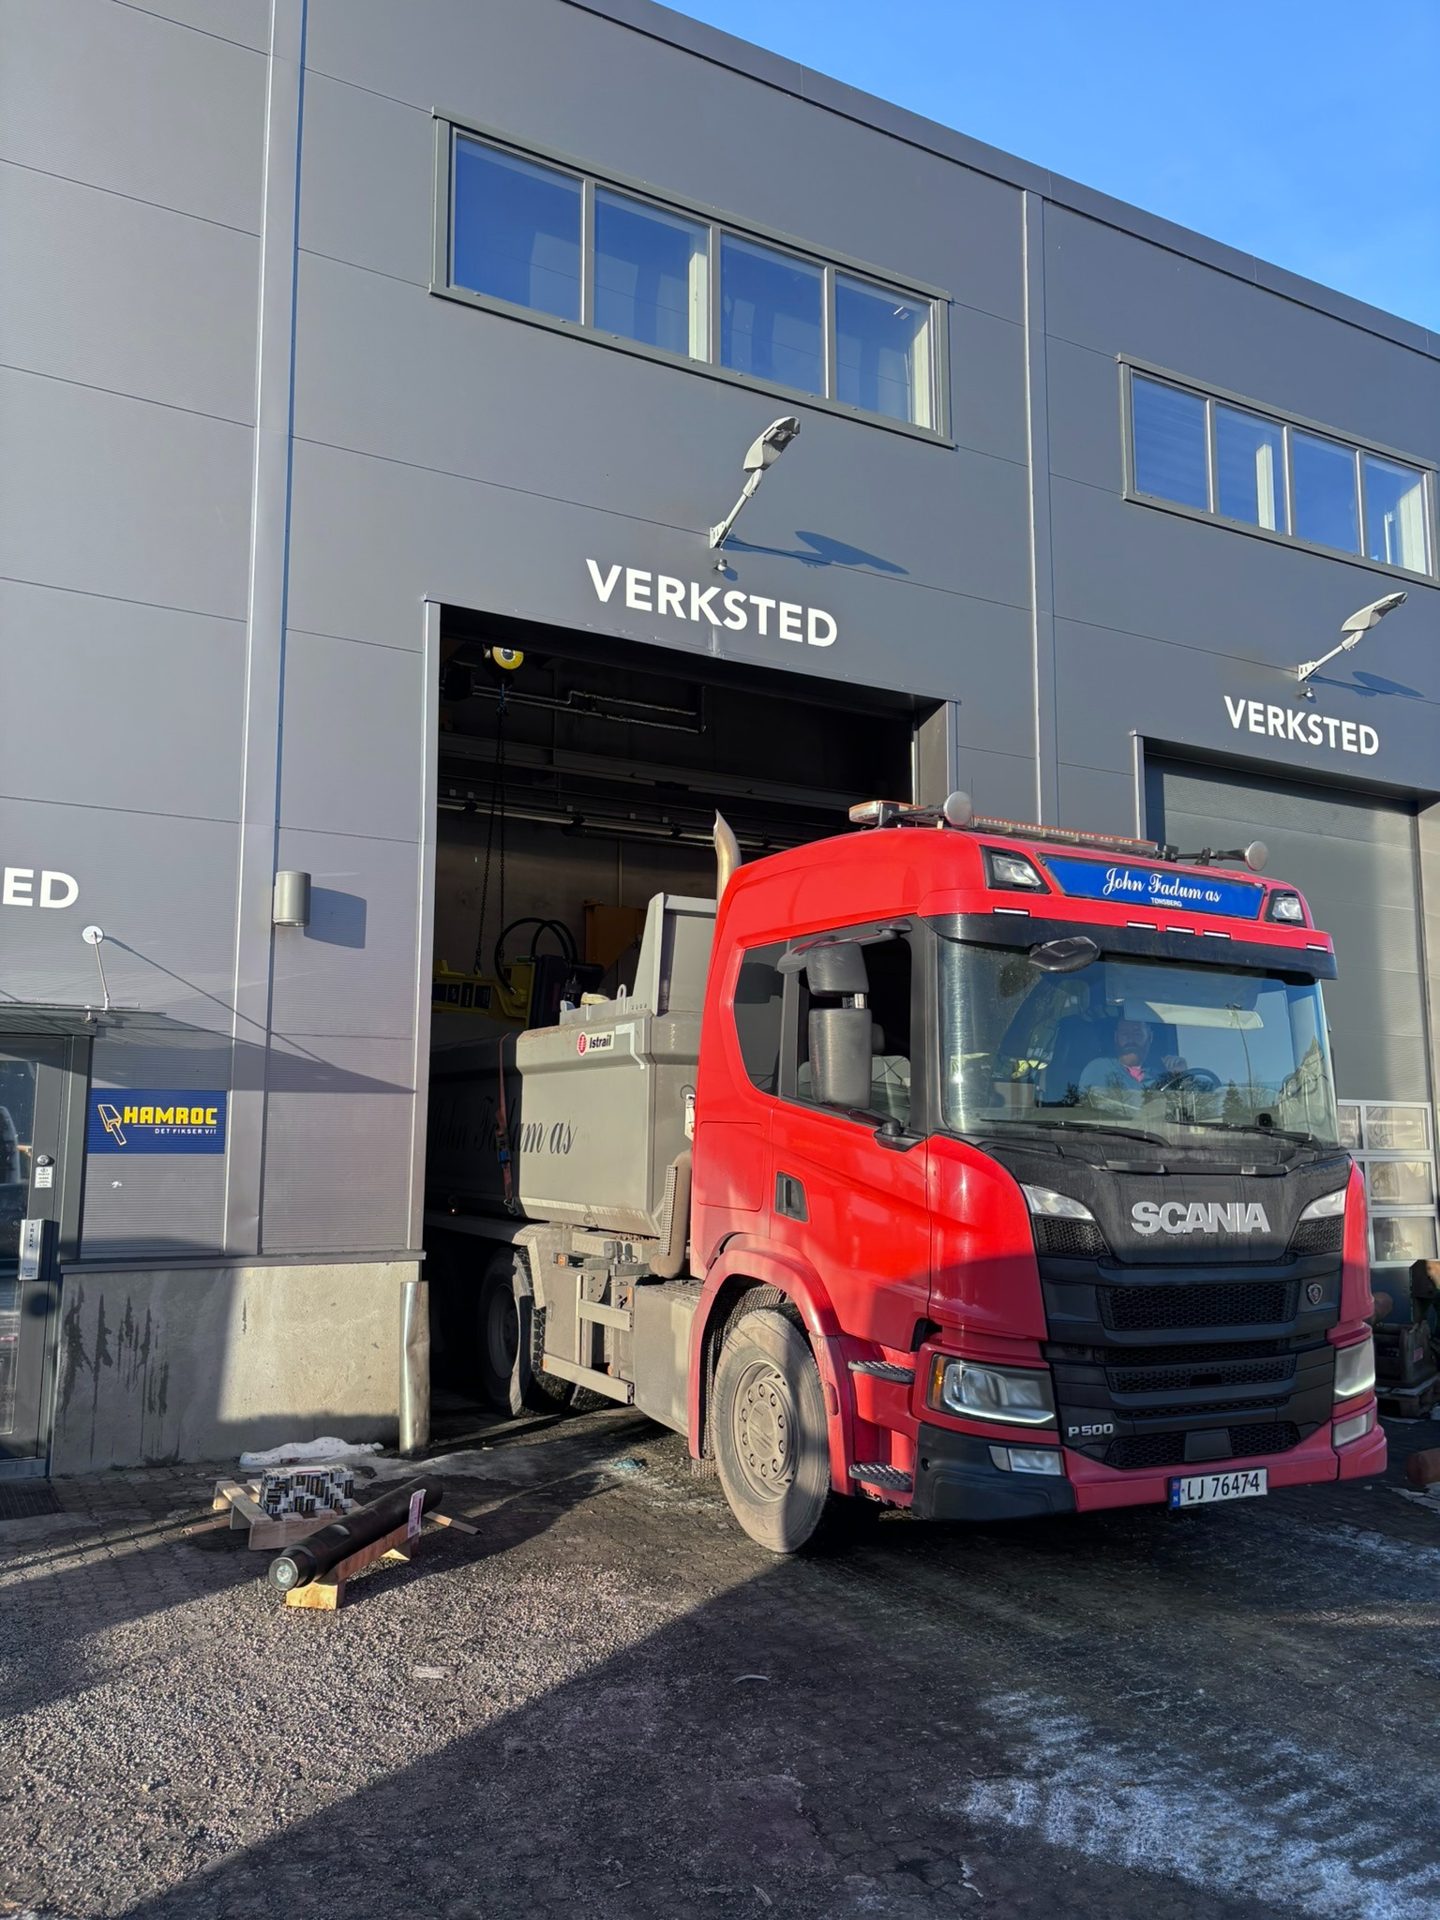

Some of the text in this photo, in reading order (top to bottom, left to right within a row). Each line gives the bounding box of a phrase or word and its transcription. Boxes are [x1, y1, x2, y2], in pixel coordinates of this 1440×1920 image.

[586, 558, 838, 647] VERKSTED
[1224, 695, 1380, 756] VERKSTED
[2, 867, 79, 909] ED
[1103, 867, 1222, 903] John Fadum as
[589, 1034, 612, 1049] Istrail
[123, 1106, 217, 1125] HAMROC
[172, 1127, 203, 1135] FIKSER
[550, 1119, 578, 1154] as
[1131, 1201, 1271, 1234] SCANIA
[1068, 1423, 1114, 1437] P 500
[1187, 1472, 1260, 1501] LJ 76474
